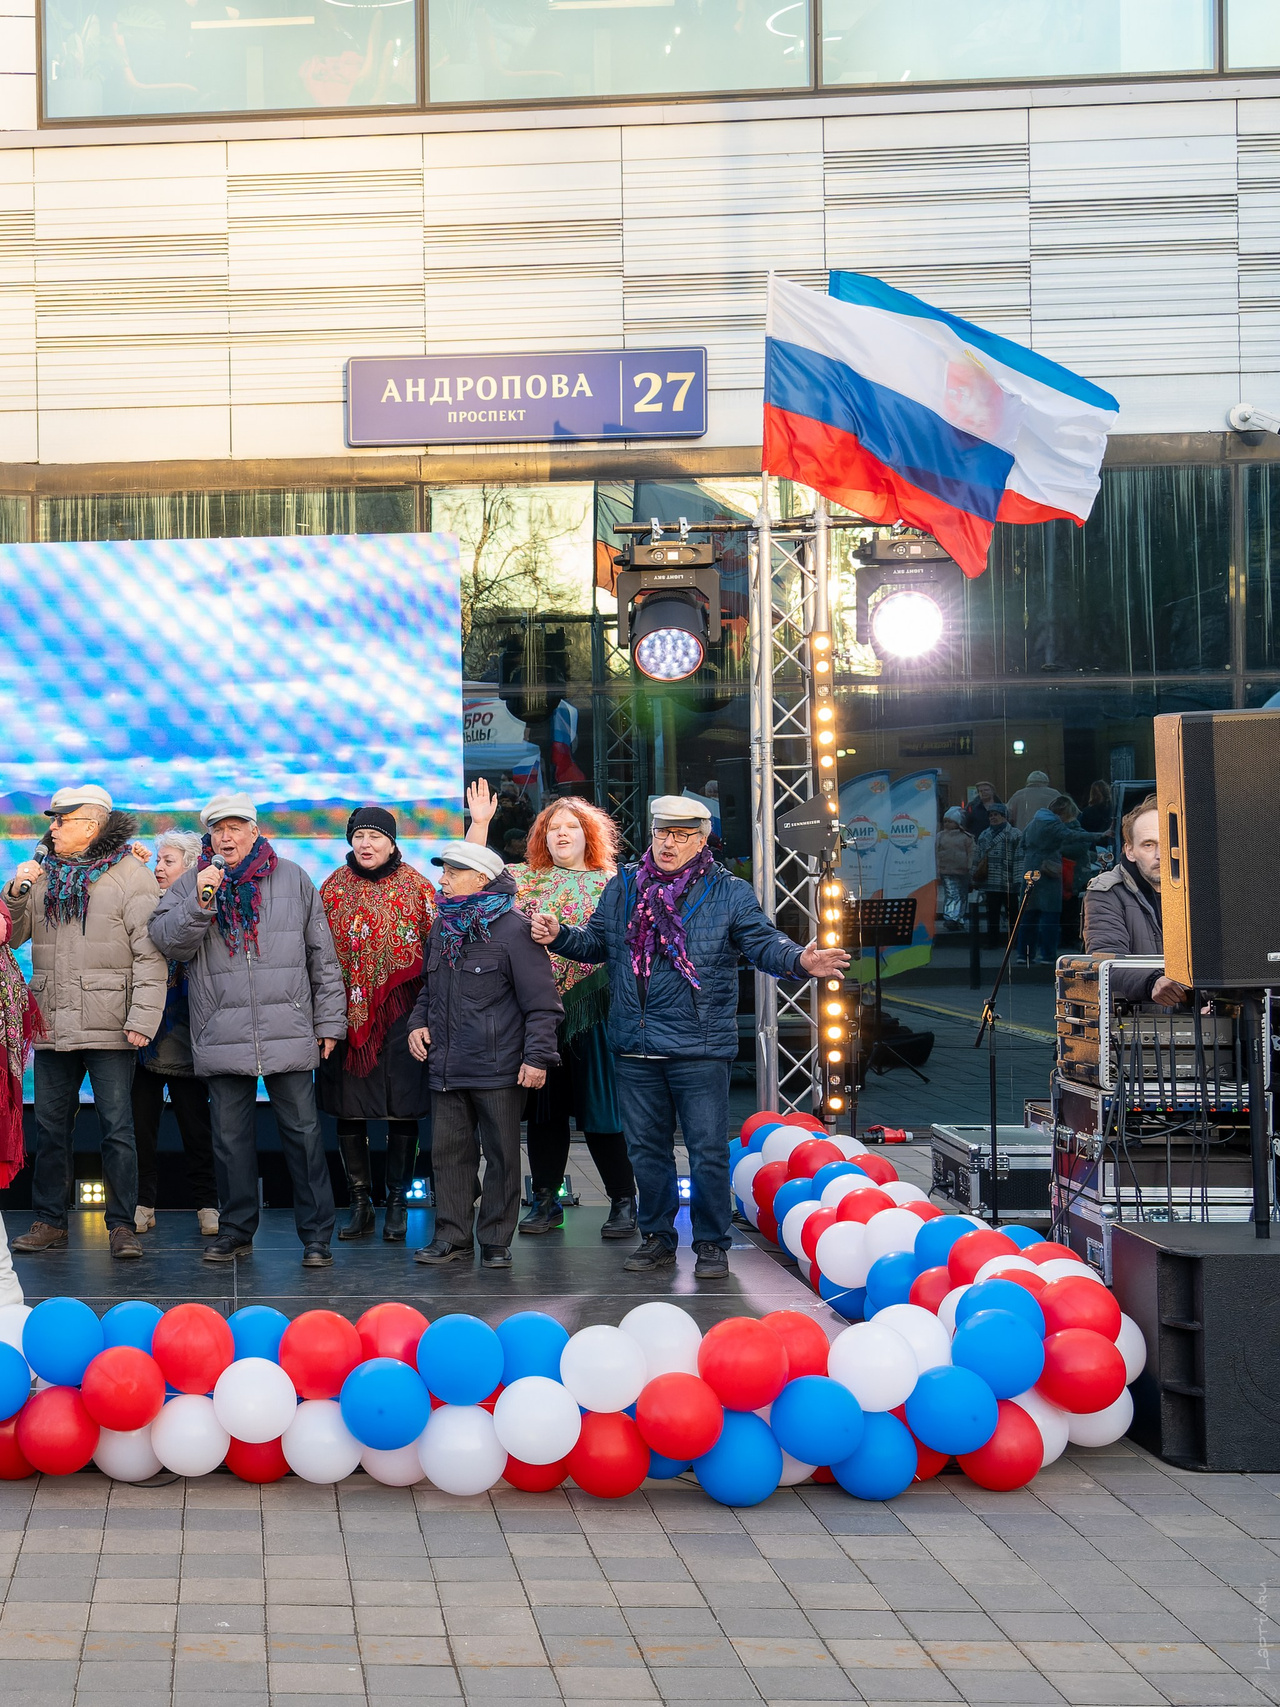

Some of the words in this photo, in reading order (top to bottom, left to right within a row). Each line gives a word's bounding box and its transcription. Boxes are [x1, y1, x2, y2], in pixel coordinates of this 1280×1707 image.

[380, 373, 594, 406] АНДРОПОВА
[632, 371, 696, 413] 27
[447, 409, 526, 423] ПРОСПЕКТ
[463, 712, 494, 730] БРО
[890, 824, 916, 834] МИР
